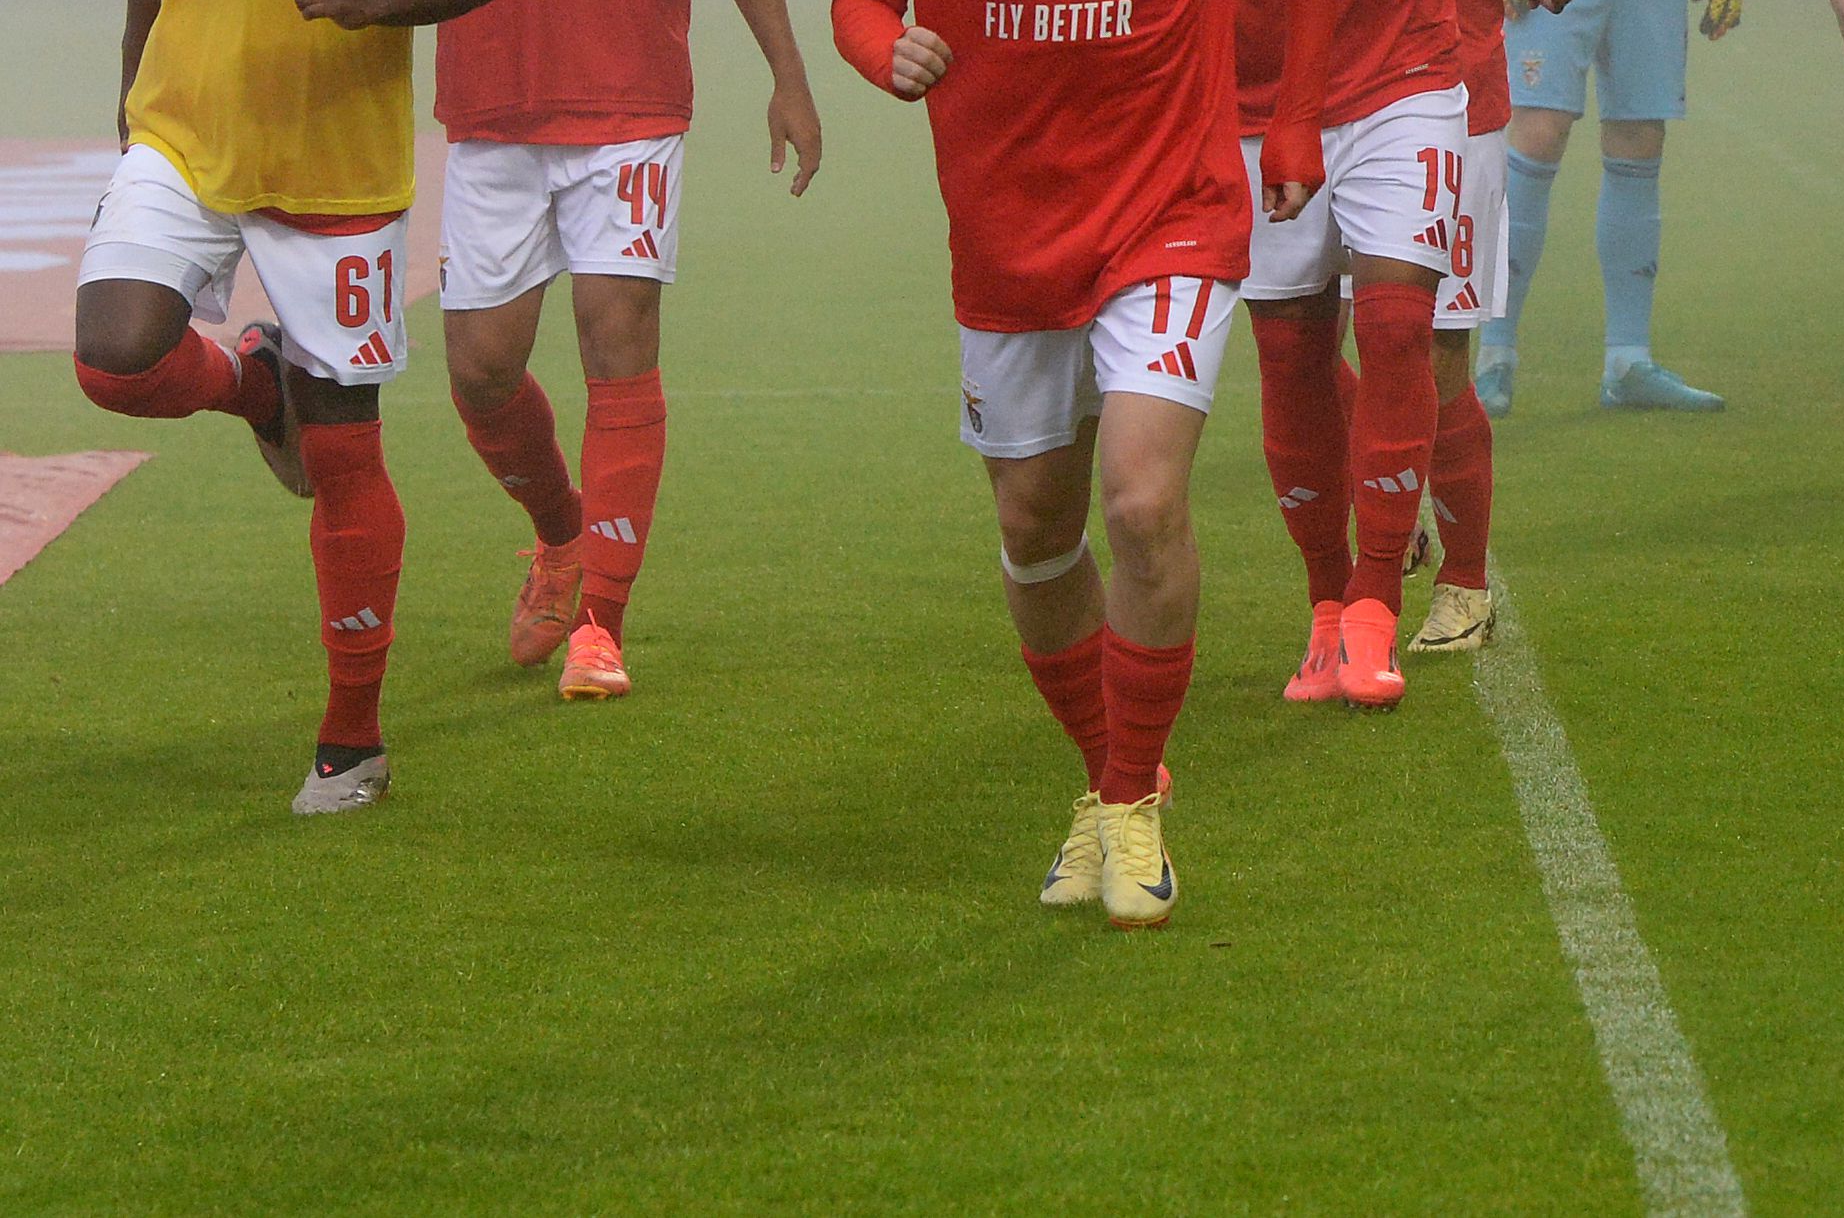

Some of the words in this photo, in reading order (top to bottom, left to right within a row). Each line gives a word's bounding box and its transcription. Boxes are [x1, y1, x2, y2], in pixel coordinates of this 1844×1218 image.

[985, 1, 1024, 41] FLY
[616, 162, 669, 229] 44
[1416, 146, 1463, 220] 14
[334, 248, 394, 329] 61
